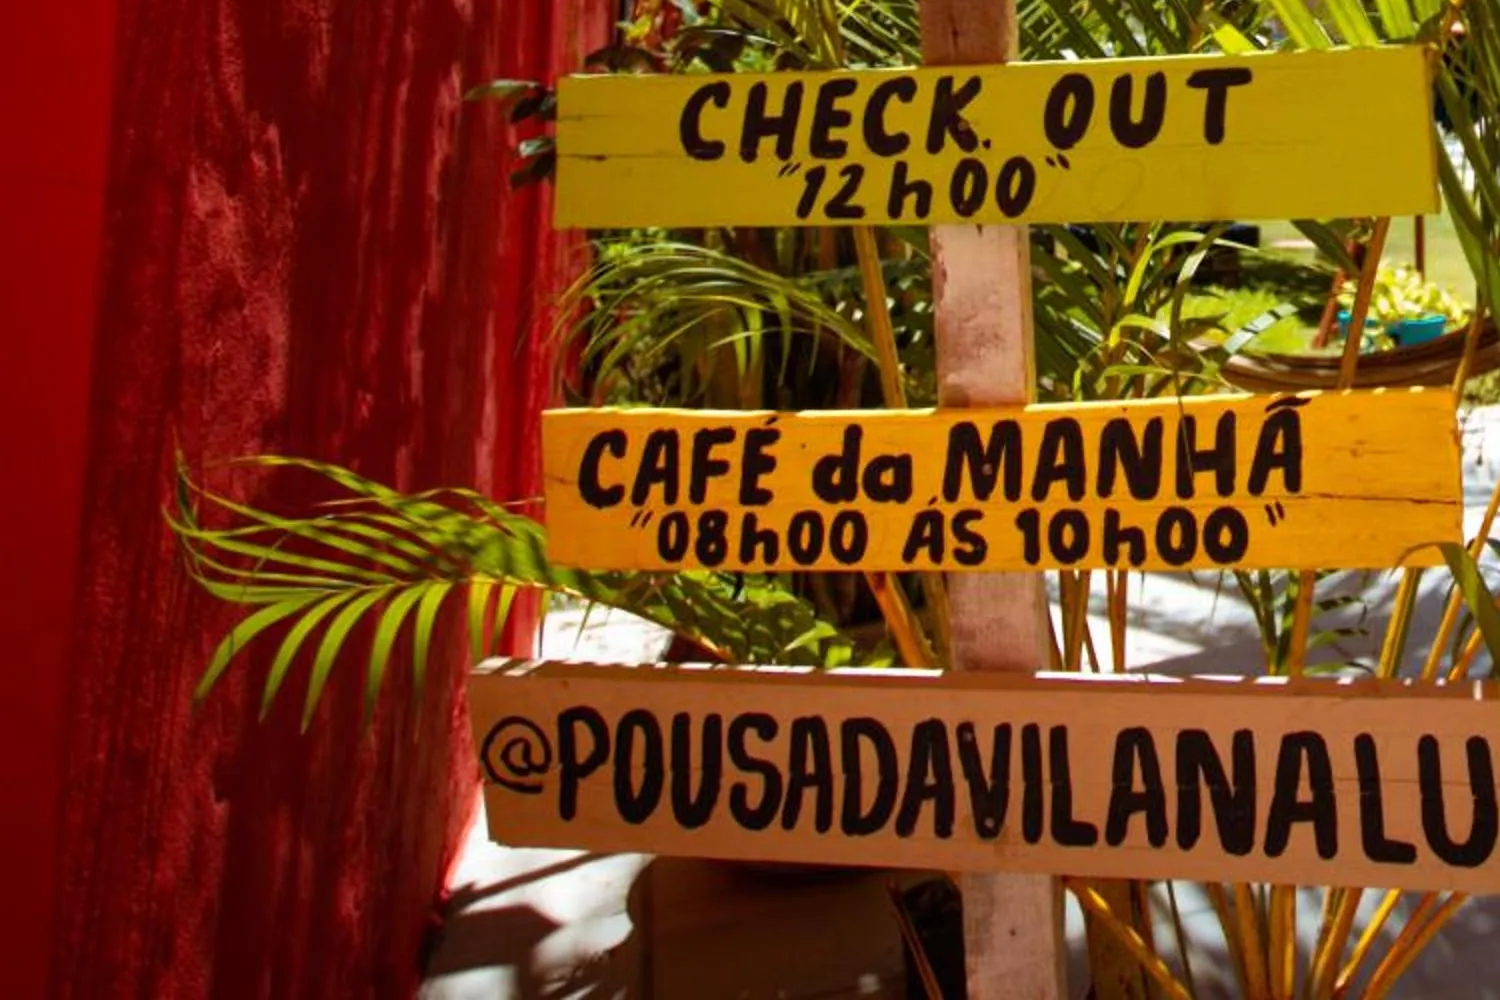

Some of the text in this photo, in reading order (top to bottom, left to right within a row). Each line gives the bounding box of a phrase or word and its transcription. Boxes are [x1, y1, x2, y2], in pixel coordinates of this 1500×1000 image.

[1043, 67, 1253, 150] OUT
[577, 396, 1312, 508] CAFÉ da MANHÃ
[480, 704, 1500, 867] @POUSADAVILANALU
